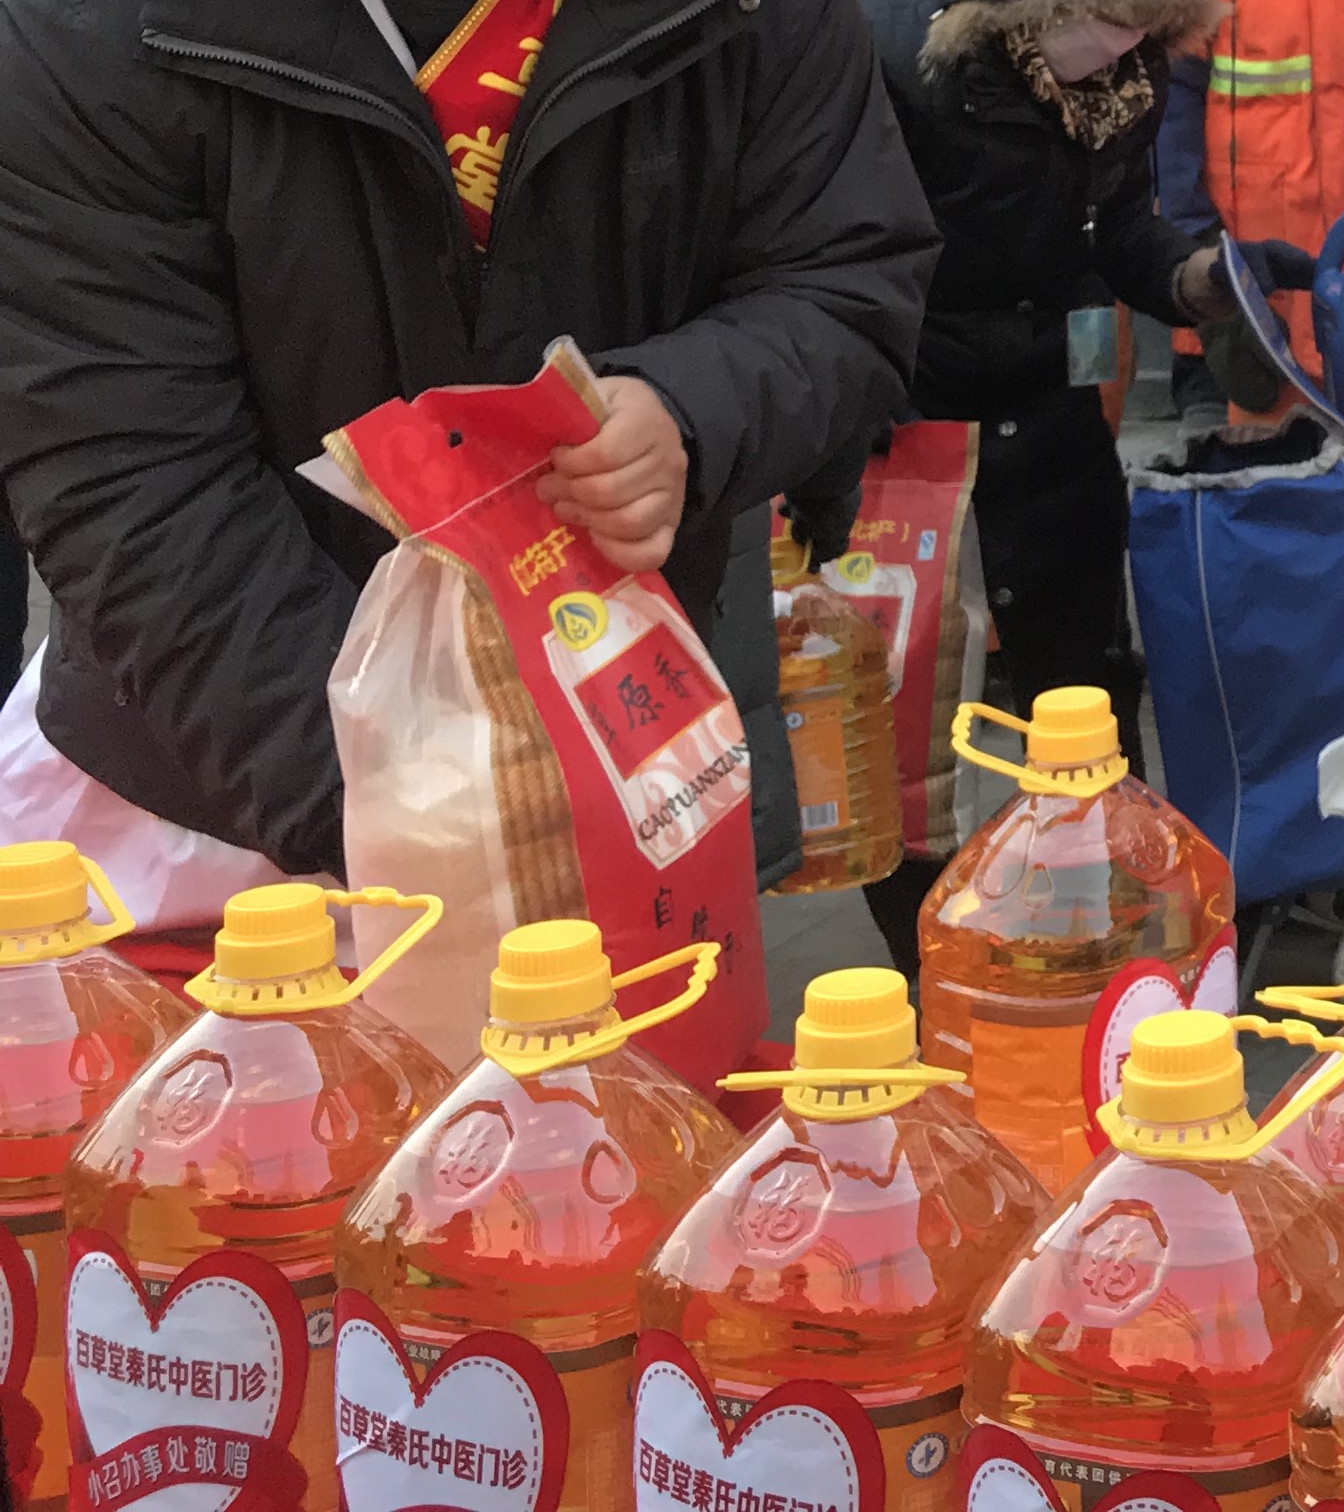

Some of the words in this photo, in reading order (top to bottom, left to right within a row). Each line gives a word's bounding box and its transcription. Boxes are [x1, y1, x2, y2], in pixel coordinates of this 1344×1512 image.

[75, 1328, 268, 1402] 百草堂秦氏中医门诊
[87, 1436, 251, 1507] 小召办事处敬赠
[339, 1394, 528, 1490] 百草堂秦氏中医门诊
